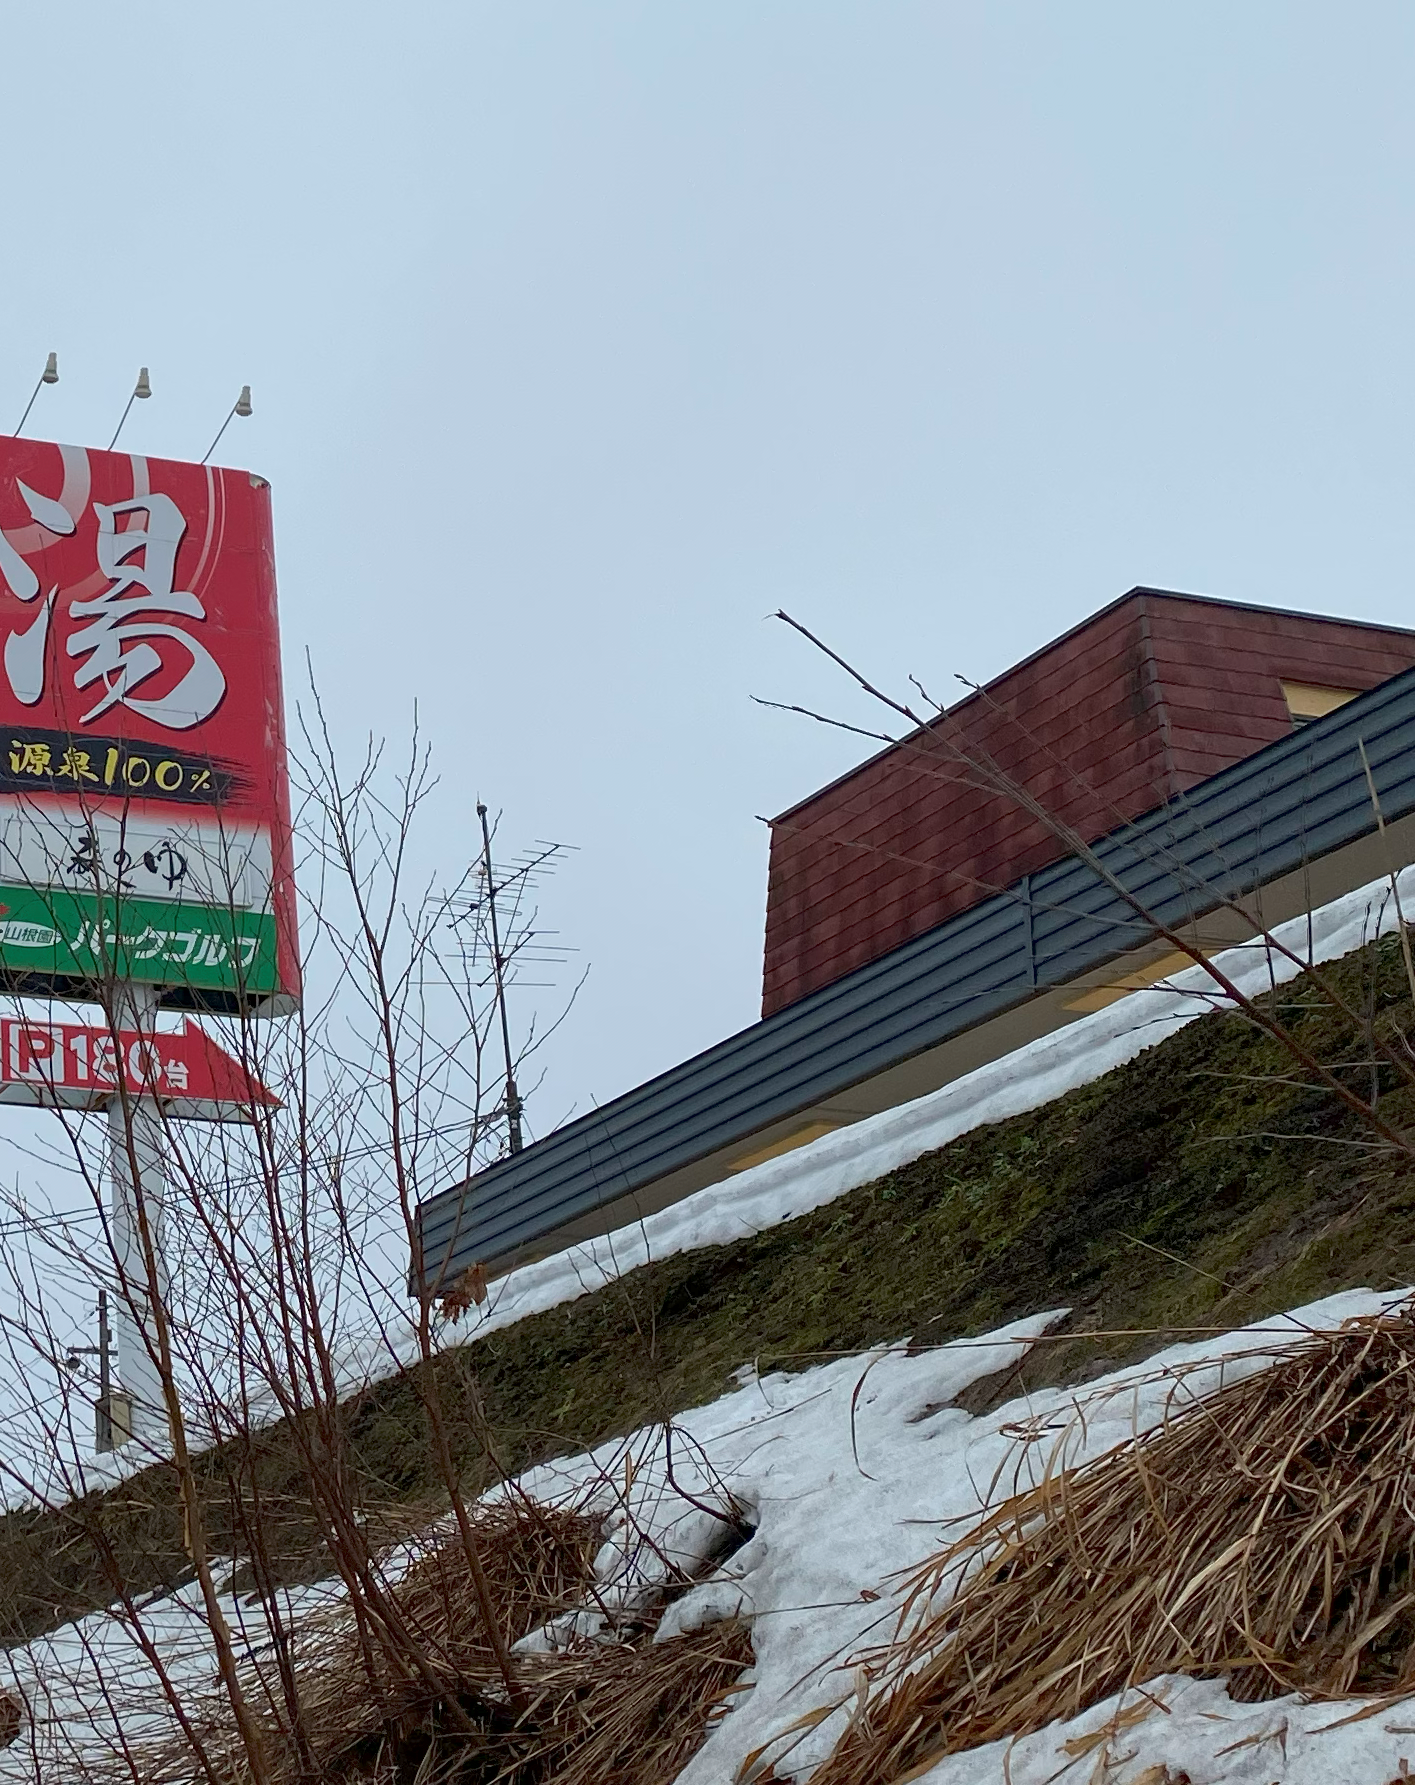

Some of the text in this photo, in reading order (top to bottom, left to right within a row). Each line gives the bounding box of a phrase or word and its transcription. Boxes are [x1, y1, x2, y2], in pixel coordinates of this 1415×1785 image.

[9, 739, 211, 794] 源泉100%
[68, 918, 262, 969] パークゴルフ
[18, 1028, 55, 1074] P
